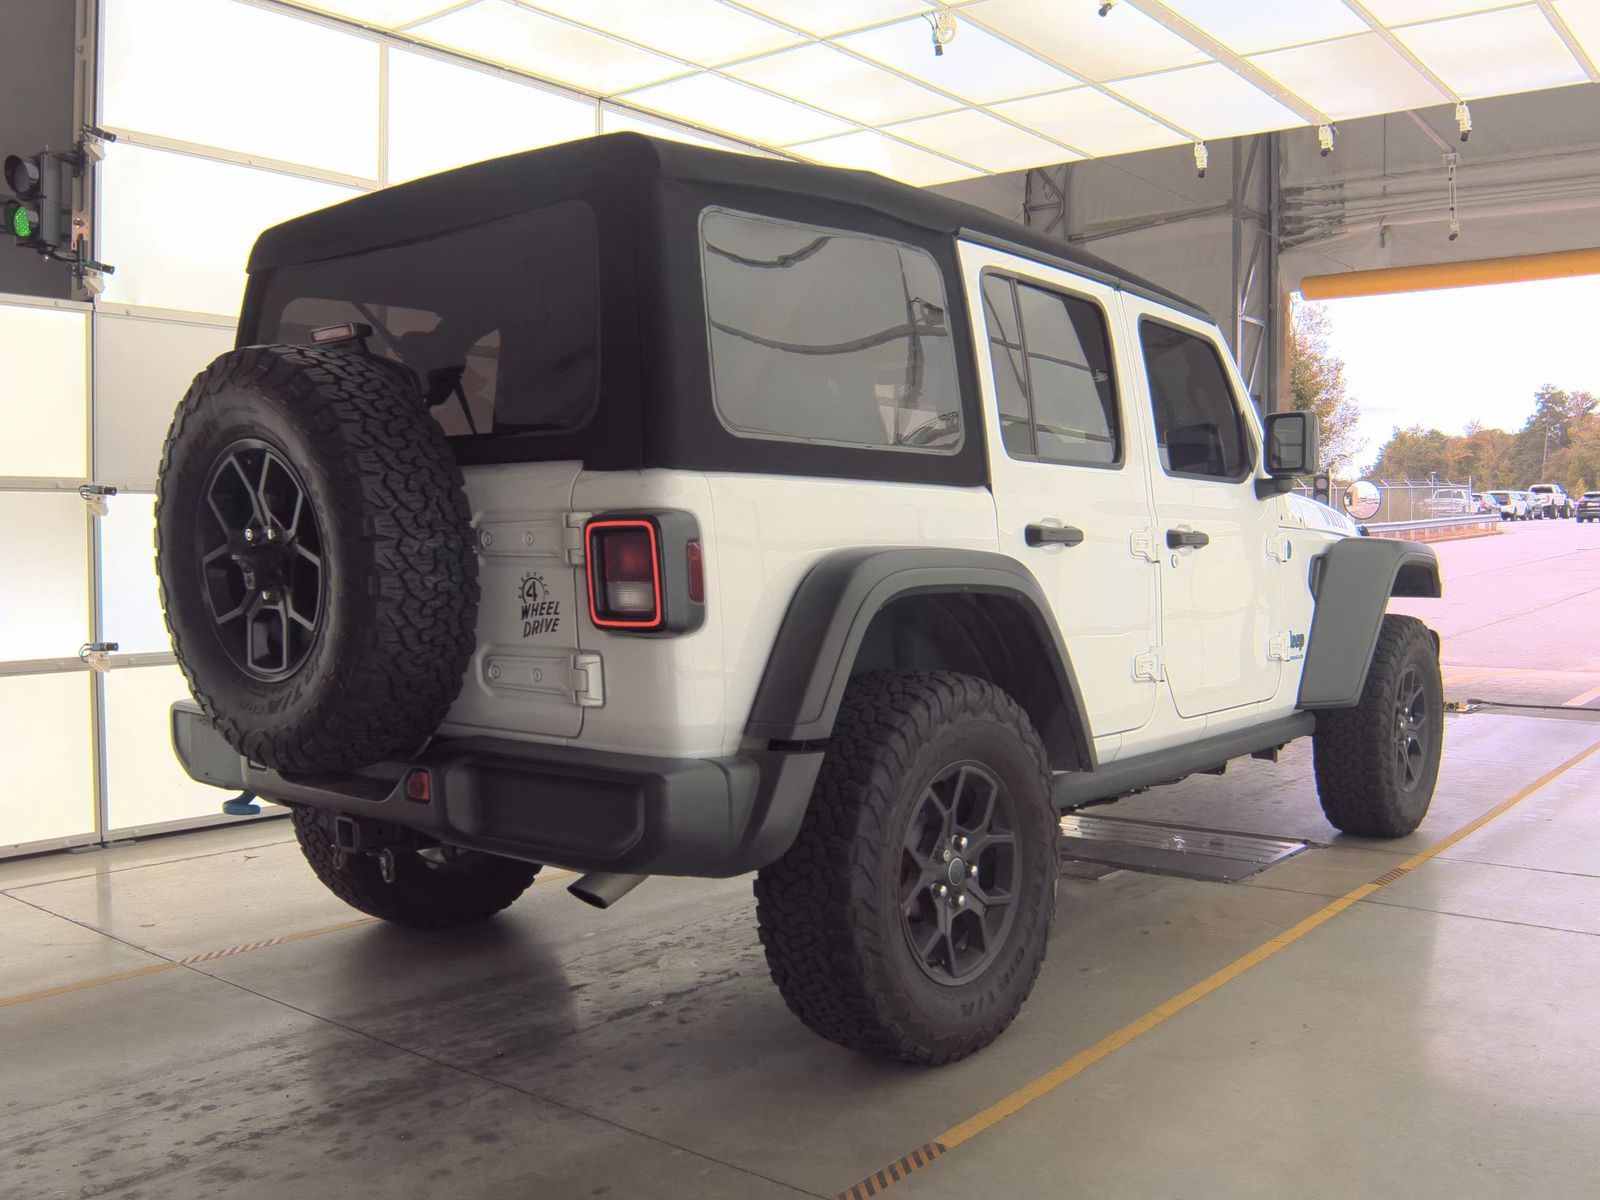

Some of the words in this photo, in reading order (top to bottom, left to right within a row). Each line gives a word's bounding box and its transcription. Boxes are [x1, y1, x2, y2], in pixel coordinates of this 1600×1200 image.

[526, 581, 537, 601] 4
[521, 601, 560, 620] WHEEL
[523, 618, 560, 638] DRIVE
